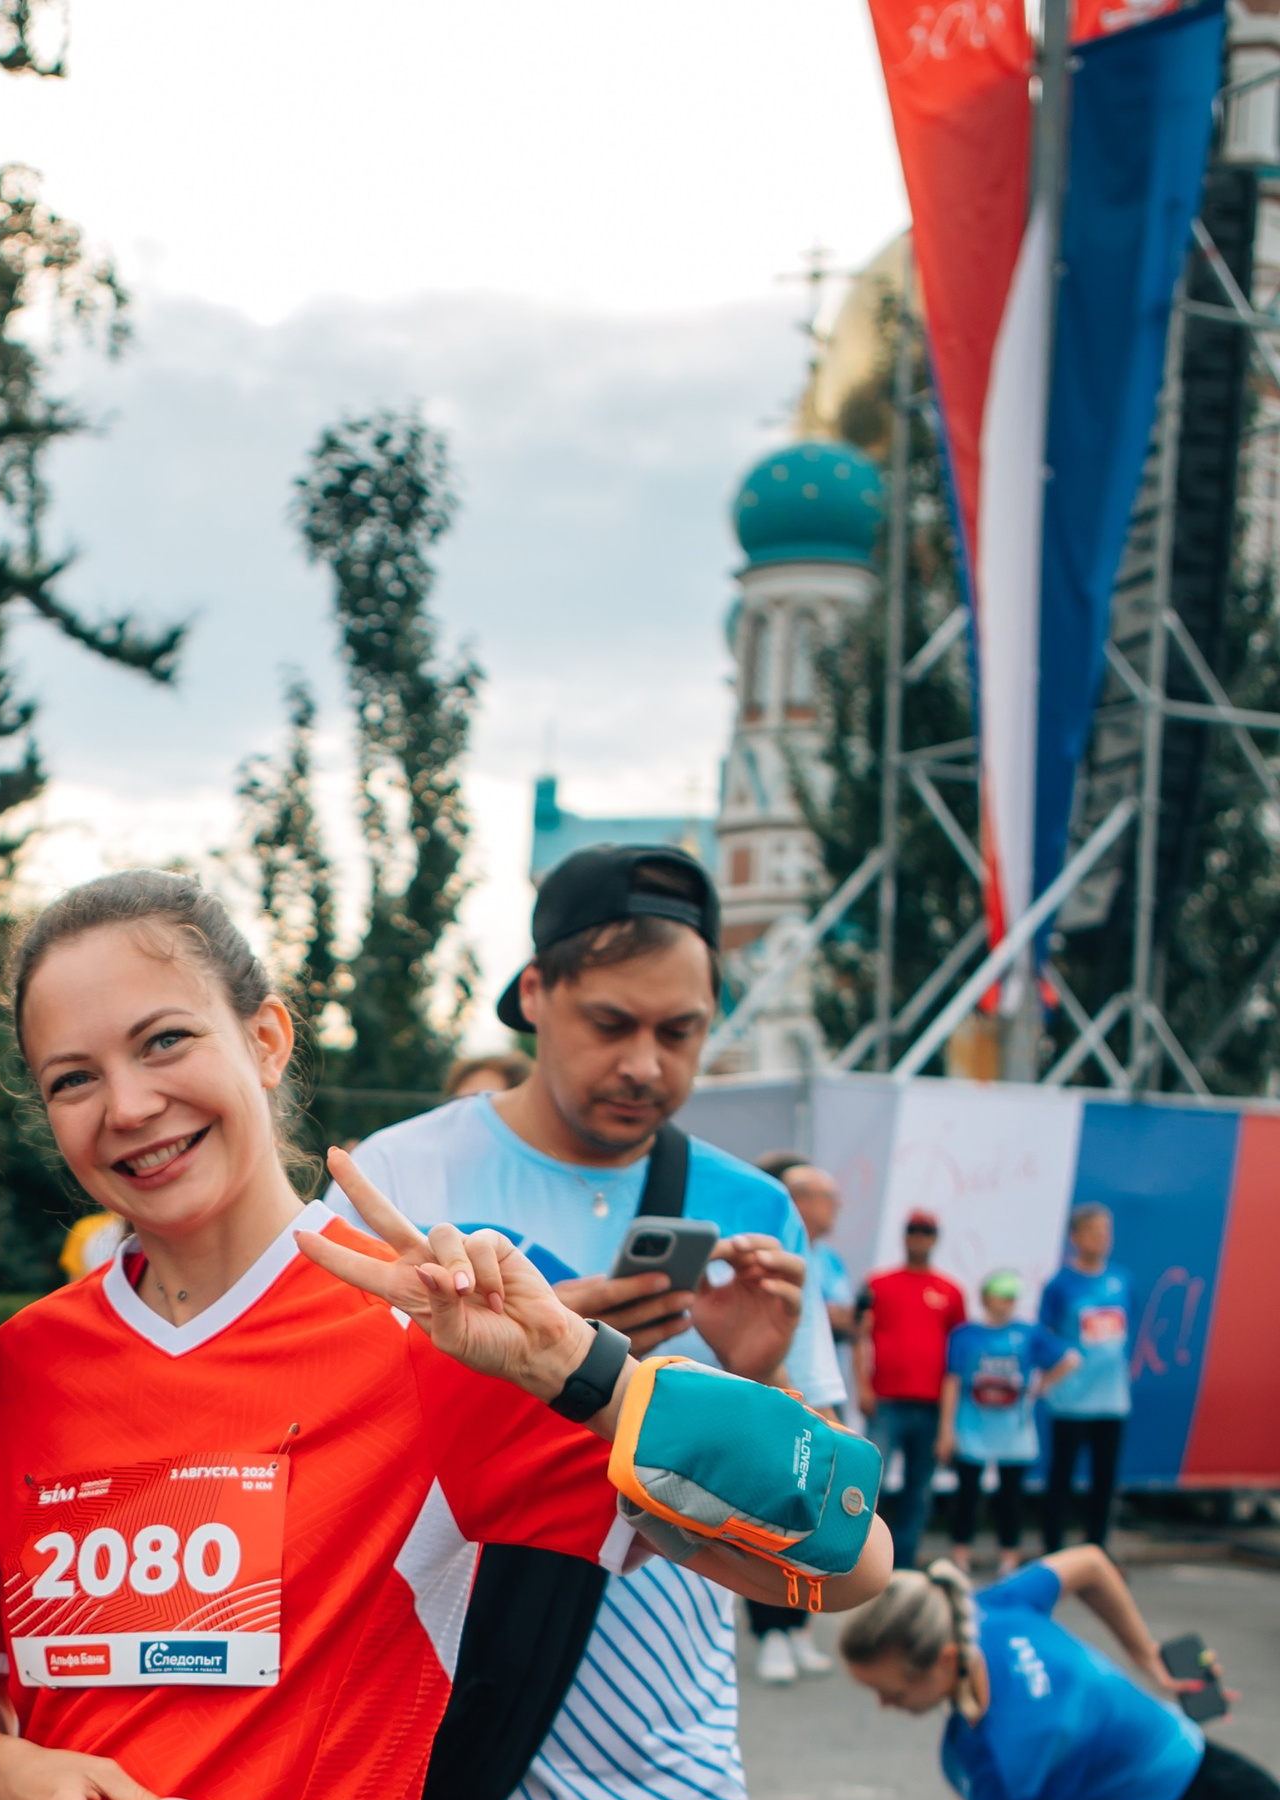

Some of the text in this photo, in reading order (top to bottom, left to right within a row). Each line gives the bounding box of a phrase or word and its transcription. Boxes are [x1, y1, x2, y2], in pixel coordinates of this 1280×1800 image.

[797, 1428, 812, 1491] FLOVEME
[170, 1466, 275, 1479] 3 АВГУСТА 2024
[242, 1480, 273, 1490] 10 КМ
[32, 1522, 241, 1599] 2080
[50, 1652, 106, 1668] Альфа Банк
[152, 1652, 222, 1667] Следопыт
